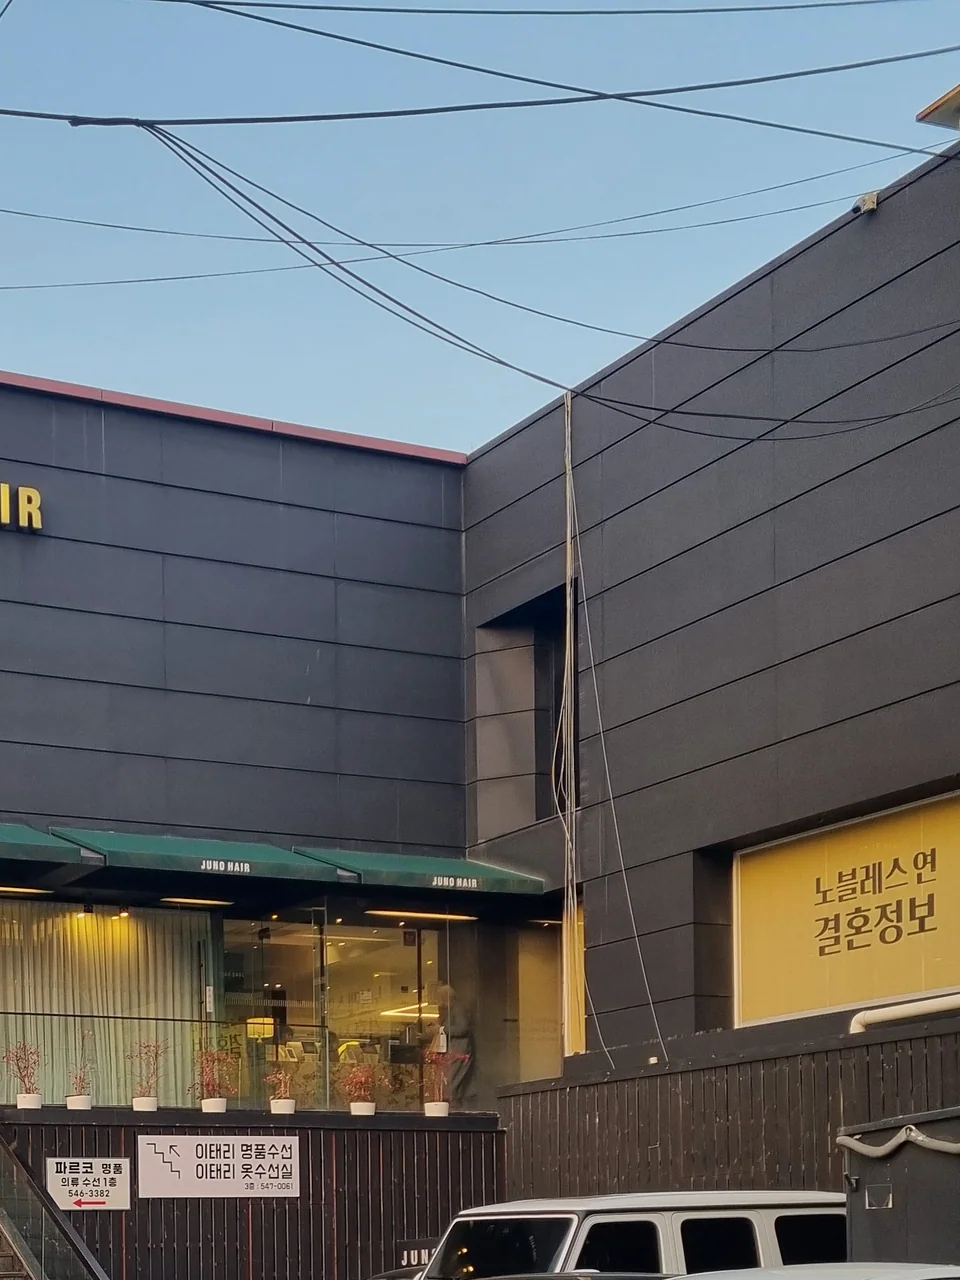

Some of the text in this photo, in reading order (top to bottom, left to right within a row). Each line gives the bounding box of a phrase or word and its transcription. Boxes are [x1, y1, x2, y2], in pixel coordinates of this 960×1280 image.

[200, 859, 251, 873] JUNO HAIR
[432, 876, 478, 888] JUNO HAIR
[814, 892, 938, 957] 결혼정보
[195, 1143, 293, 1160] 이태리 명품수선
[54, 1161, 123, 1175] 파르코 명품
[195, 1163, 293, 1180] 이태리 옷수선실
[60, 1176, 118, 1188] 의류 수선 1층
[68, 1189, 110, 1198] 546-3382
[401, 1248, 435, 1266] JUN
